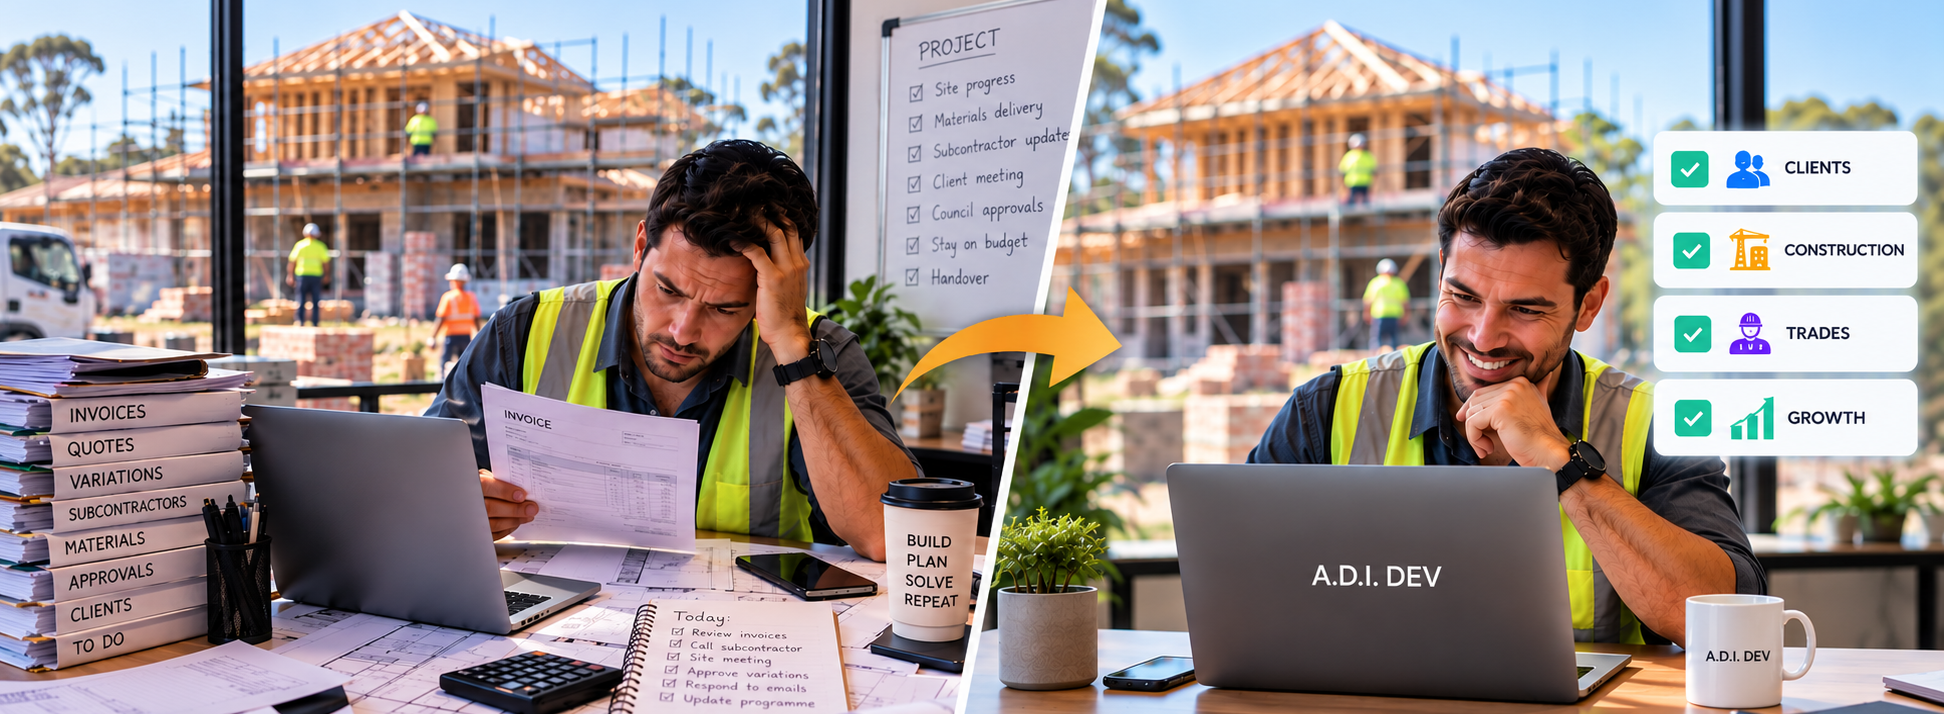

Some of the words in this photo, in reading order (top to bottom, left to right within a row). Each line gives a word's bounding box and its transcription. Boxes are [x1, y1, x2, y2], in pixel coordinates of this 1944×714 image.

[919, 28, 1000, 61] PROJECT
[936, 82, 958, 97] Site
[967, 74, 1015, 98] progress
[935, 107, 987, 128] Materials
[995, 102, 1042, 120] delivery
[934, 135, 1017, 158] Subcontractor
[933, 172, 967, 189] Client
[977, 168, 1023, 188] meeting
[932, 202, 973, 221] Council
[983, 196, 1043, 222] approvals
[932, 237, 957, 258] Stay
[964, 241, 977, 249] on
[986, 232, 1028, 256] budget
[932, 268, 989, 285] Handover
[71, 404, 146, 422] INVOICES
[505, 410, 551, 431] INVOICE
[67, 438, 134, 457] QUOTES
[70, 467, 163, 489] VARIATIONS
[69, 496, 187, 521] SUBCONTRACTORS
[65, 532, 145, 555] MATERIALS
[908, 534, 951, 548] BUILD
[908, 554, 947, 568] PLAN
[69, 563, 154, 591] APPROVALS
[906, 574, 953, 588] SOLVE
[1312, 565, 1378, 586] A.D.I.
[1387, 566, 1441, 587] DEV
[71, 598, 132, 623] CLIENTS
[905, 593, 958, 608] REPEAT
[674, 611, 730, 627] Today:
[73, 639, 94, 654] TO
[103, 632, 124, 649] DO
[692, 628, 732, 638] Review
[741, 631, 787, 639] invoices
[691, 641, 713, 650] Call
[722, 644, 802, 652] subcontractor
[1706, 651, 1739, 662] A.D.I.
[1744, 651, 1770, 661] DEV
[690, 653, 713, 663] Site
[723, 656, 771, 667] meeting
[687, 667, 738, 678] Approve
[747, 671, 808, 679] variations
[686, 680, 738, 692] Respond
[747, 683, 759, 691] to
[767, 684, 806, 692] emails
[684, 694, 732, 706] Update
[741, 700, 814, 709] programme
